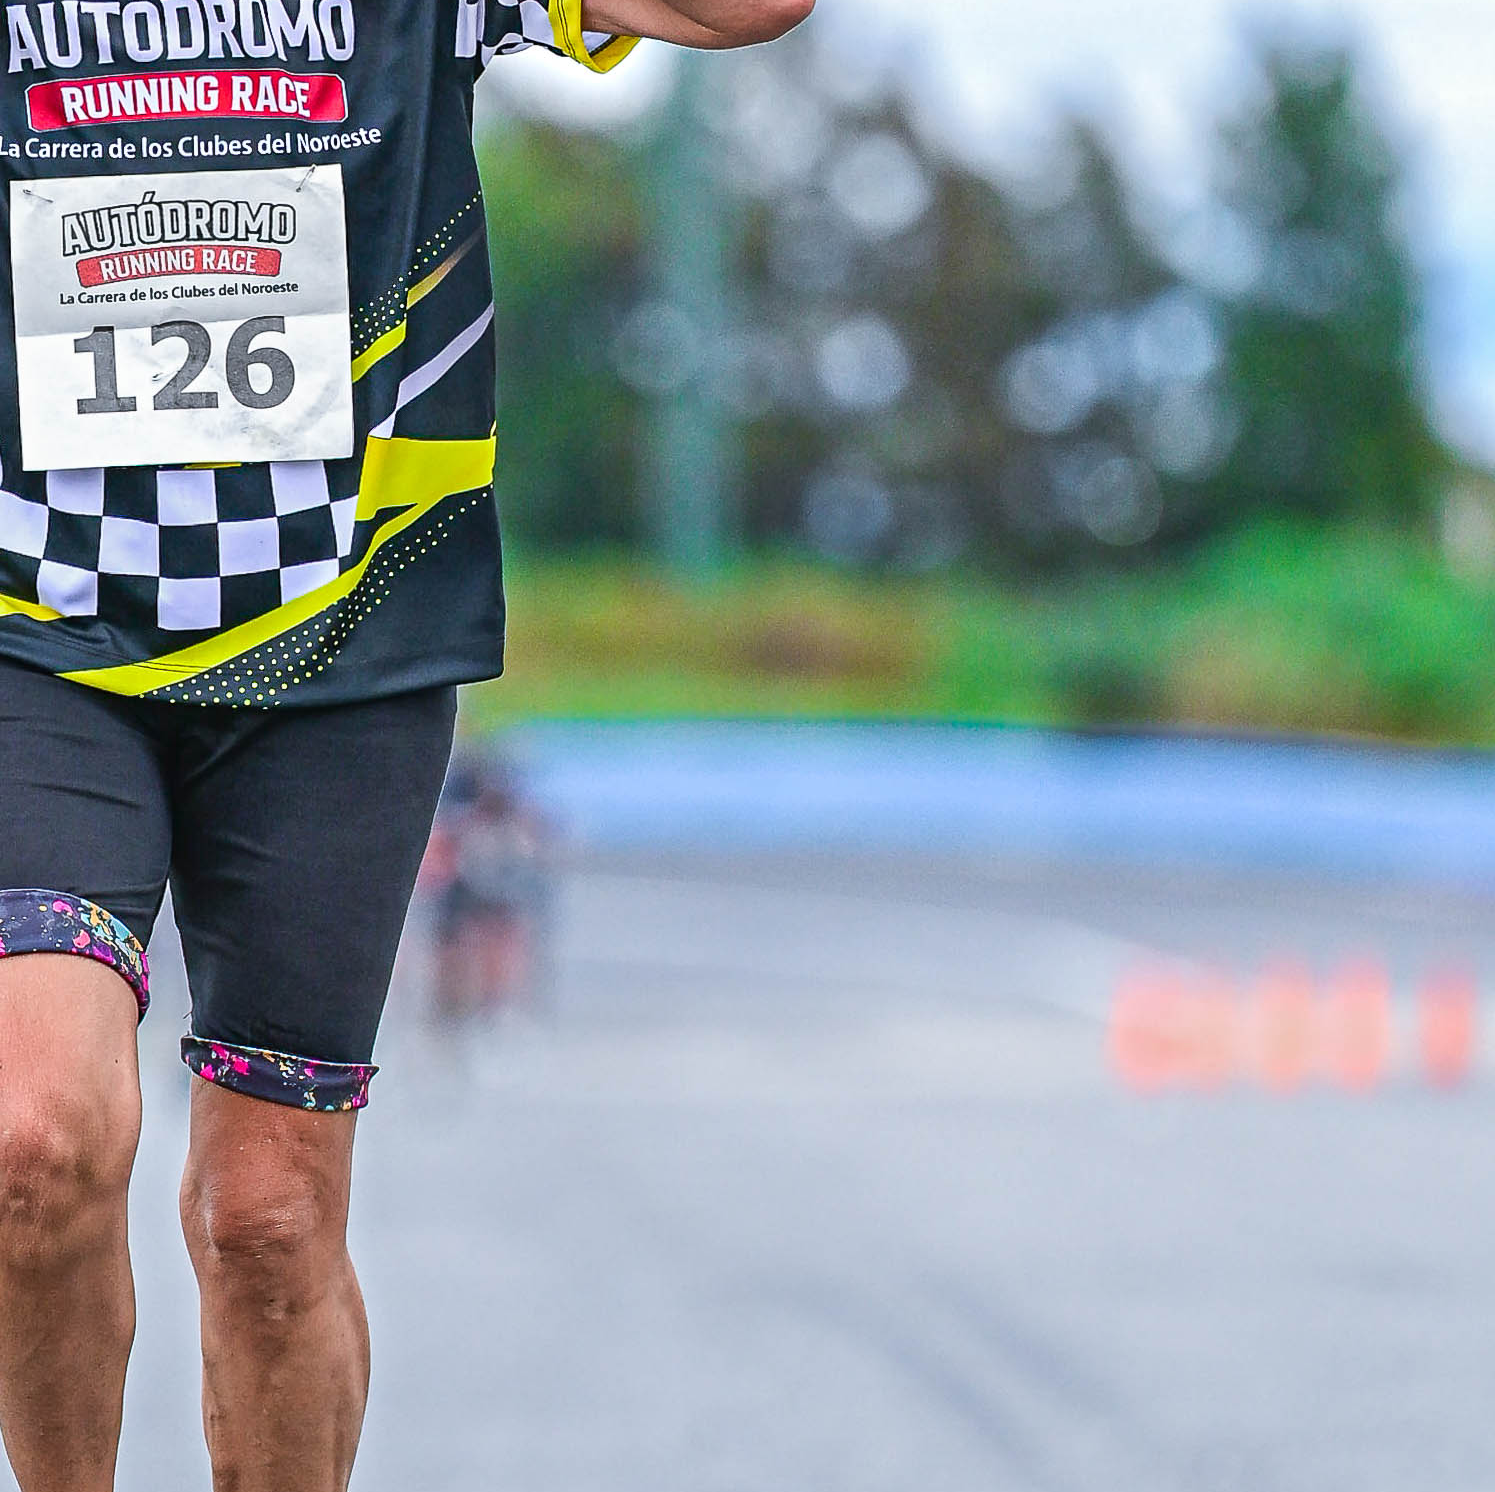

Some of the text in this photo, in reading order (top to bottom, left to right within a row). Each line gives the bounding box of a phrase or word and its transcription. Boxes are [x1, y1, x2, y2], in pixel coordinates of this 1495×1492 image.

[60, 75, 312, 123] RUNNING RACE
[25, 137, 103, 159] Carrera
[108, 137, 136, 159] de
[141, 136, 173, 158] los
[177, 134, 253, 157] Clubes
[257, 132, 293, 155] del
[296, 126, 382, 154] Noroeste
[62, 191, 296, 256] AUTÓDROMO
[99, 247, 259, 281] RUNNING RACE
[59, 281, 300, 305] La Carrera de los Clubes del Noroeste
[72, 315, 296, 415] 126
